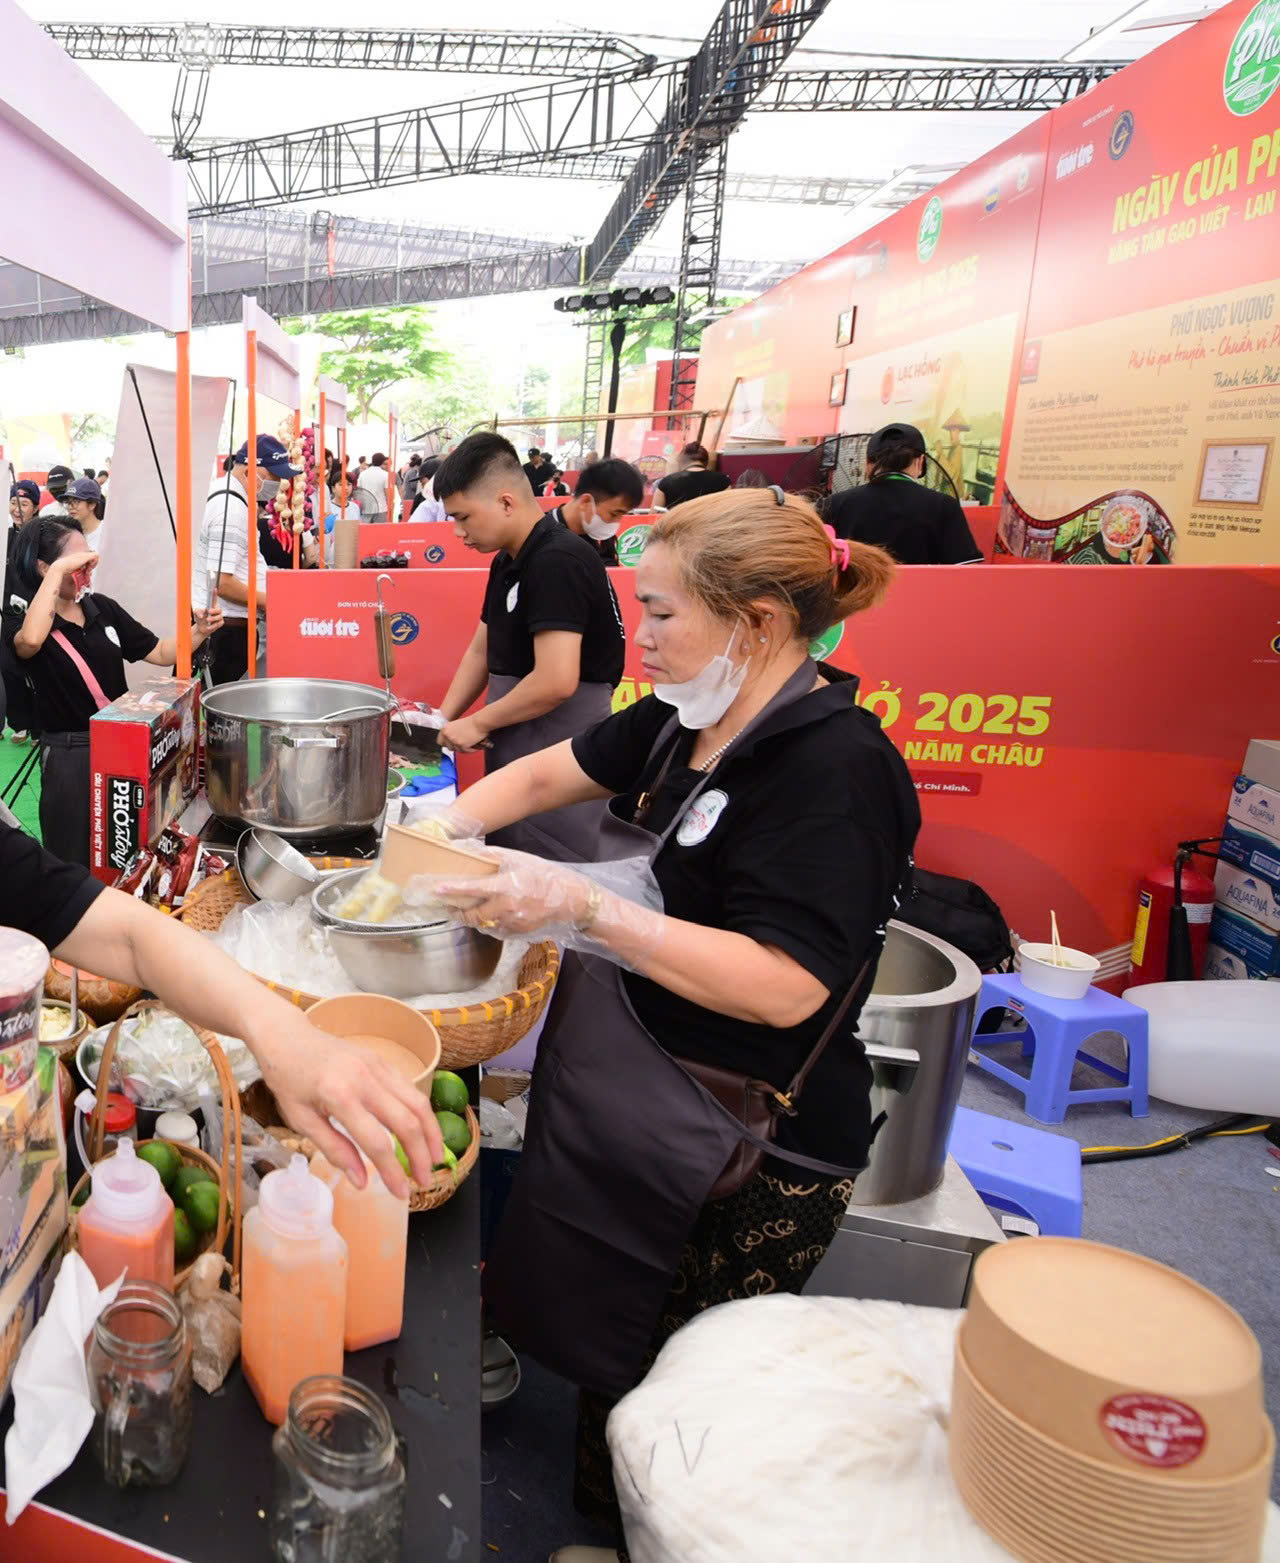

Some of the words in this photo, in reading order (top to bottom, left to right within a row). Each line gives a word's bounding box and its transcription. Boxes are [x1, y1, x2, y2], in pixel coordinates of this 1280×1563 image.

[1112, 171, 1180, 234] NGÀY
[1183, 144, 1239, 207] CỦA
[1244, 189, 1277, 221] LAN
[1194, 303, 1228, 334] NGỌC
[915, 692, 1052, 735] 2025
[904, 739, 964, 763] NĂM
[971, 742, 1044, 767] CHÂU
[924, 783, 941, 791] Chí
[942, 783, 971, 792] Minh.
[1226, 884, 1269, 914] AQUAFINA
